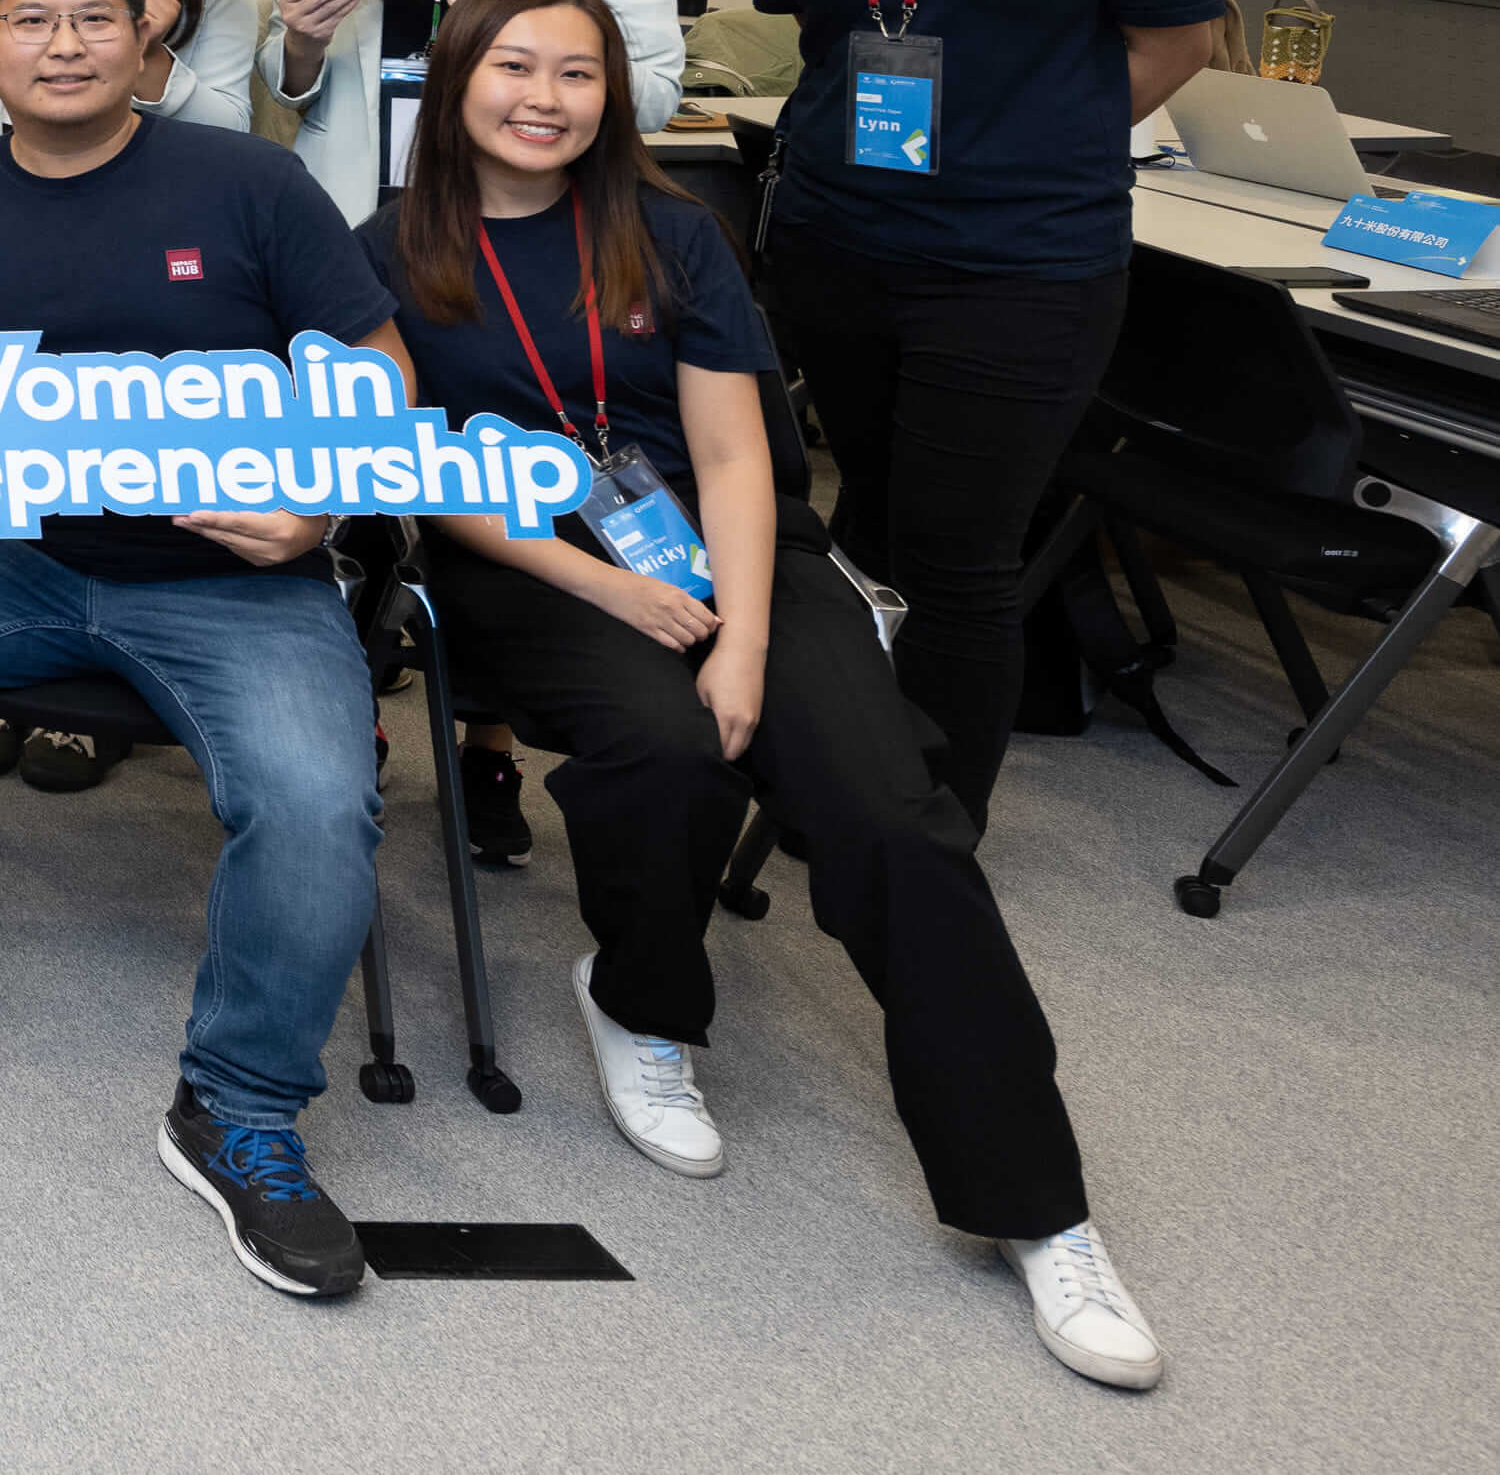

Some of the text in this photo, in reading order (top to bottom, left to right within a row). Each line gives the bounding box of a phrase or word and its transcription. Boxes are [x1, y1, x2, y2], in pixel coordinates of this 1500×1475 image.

[859, 116, 901, 132] Lynn
[1339, 215, 1449, 249] 九十米股份有限公司
[172, 265, 199, 276] HUB
[305, 341, 395, 419] in
[635, 544, 687, 576] Micky
